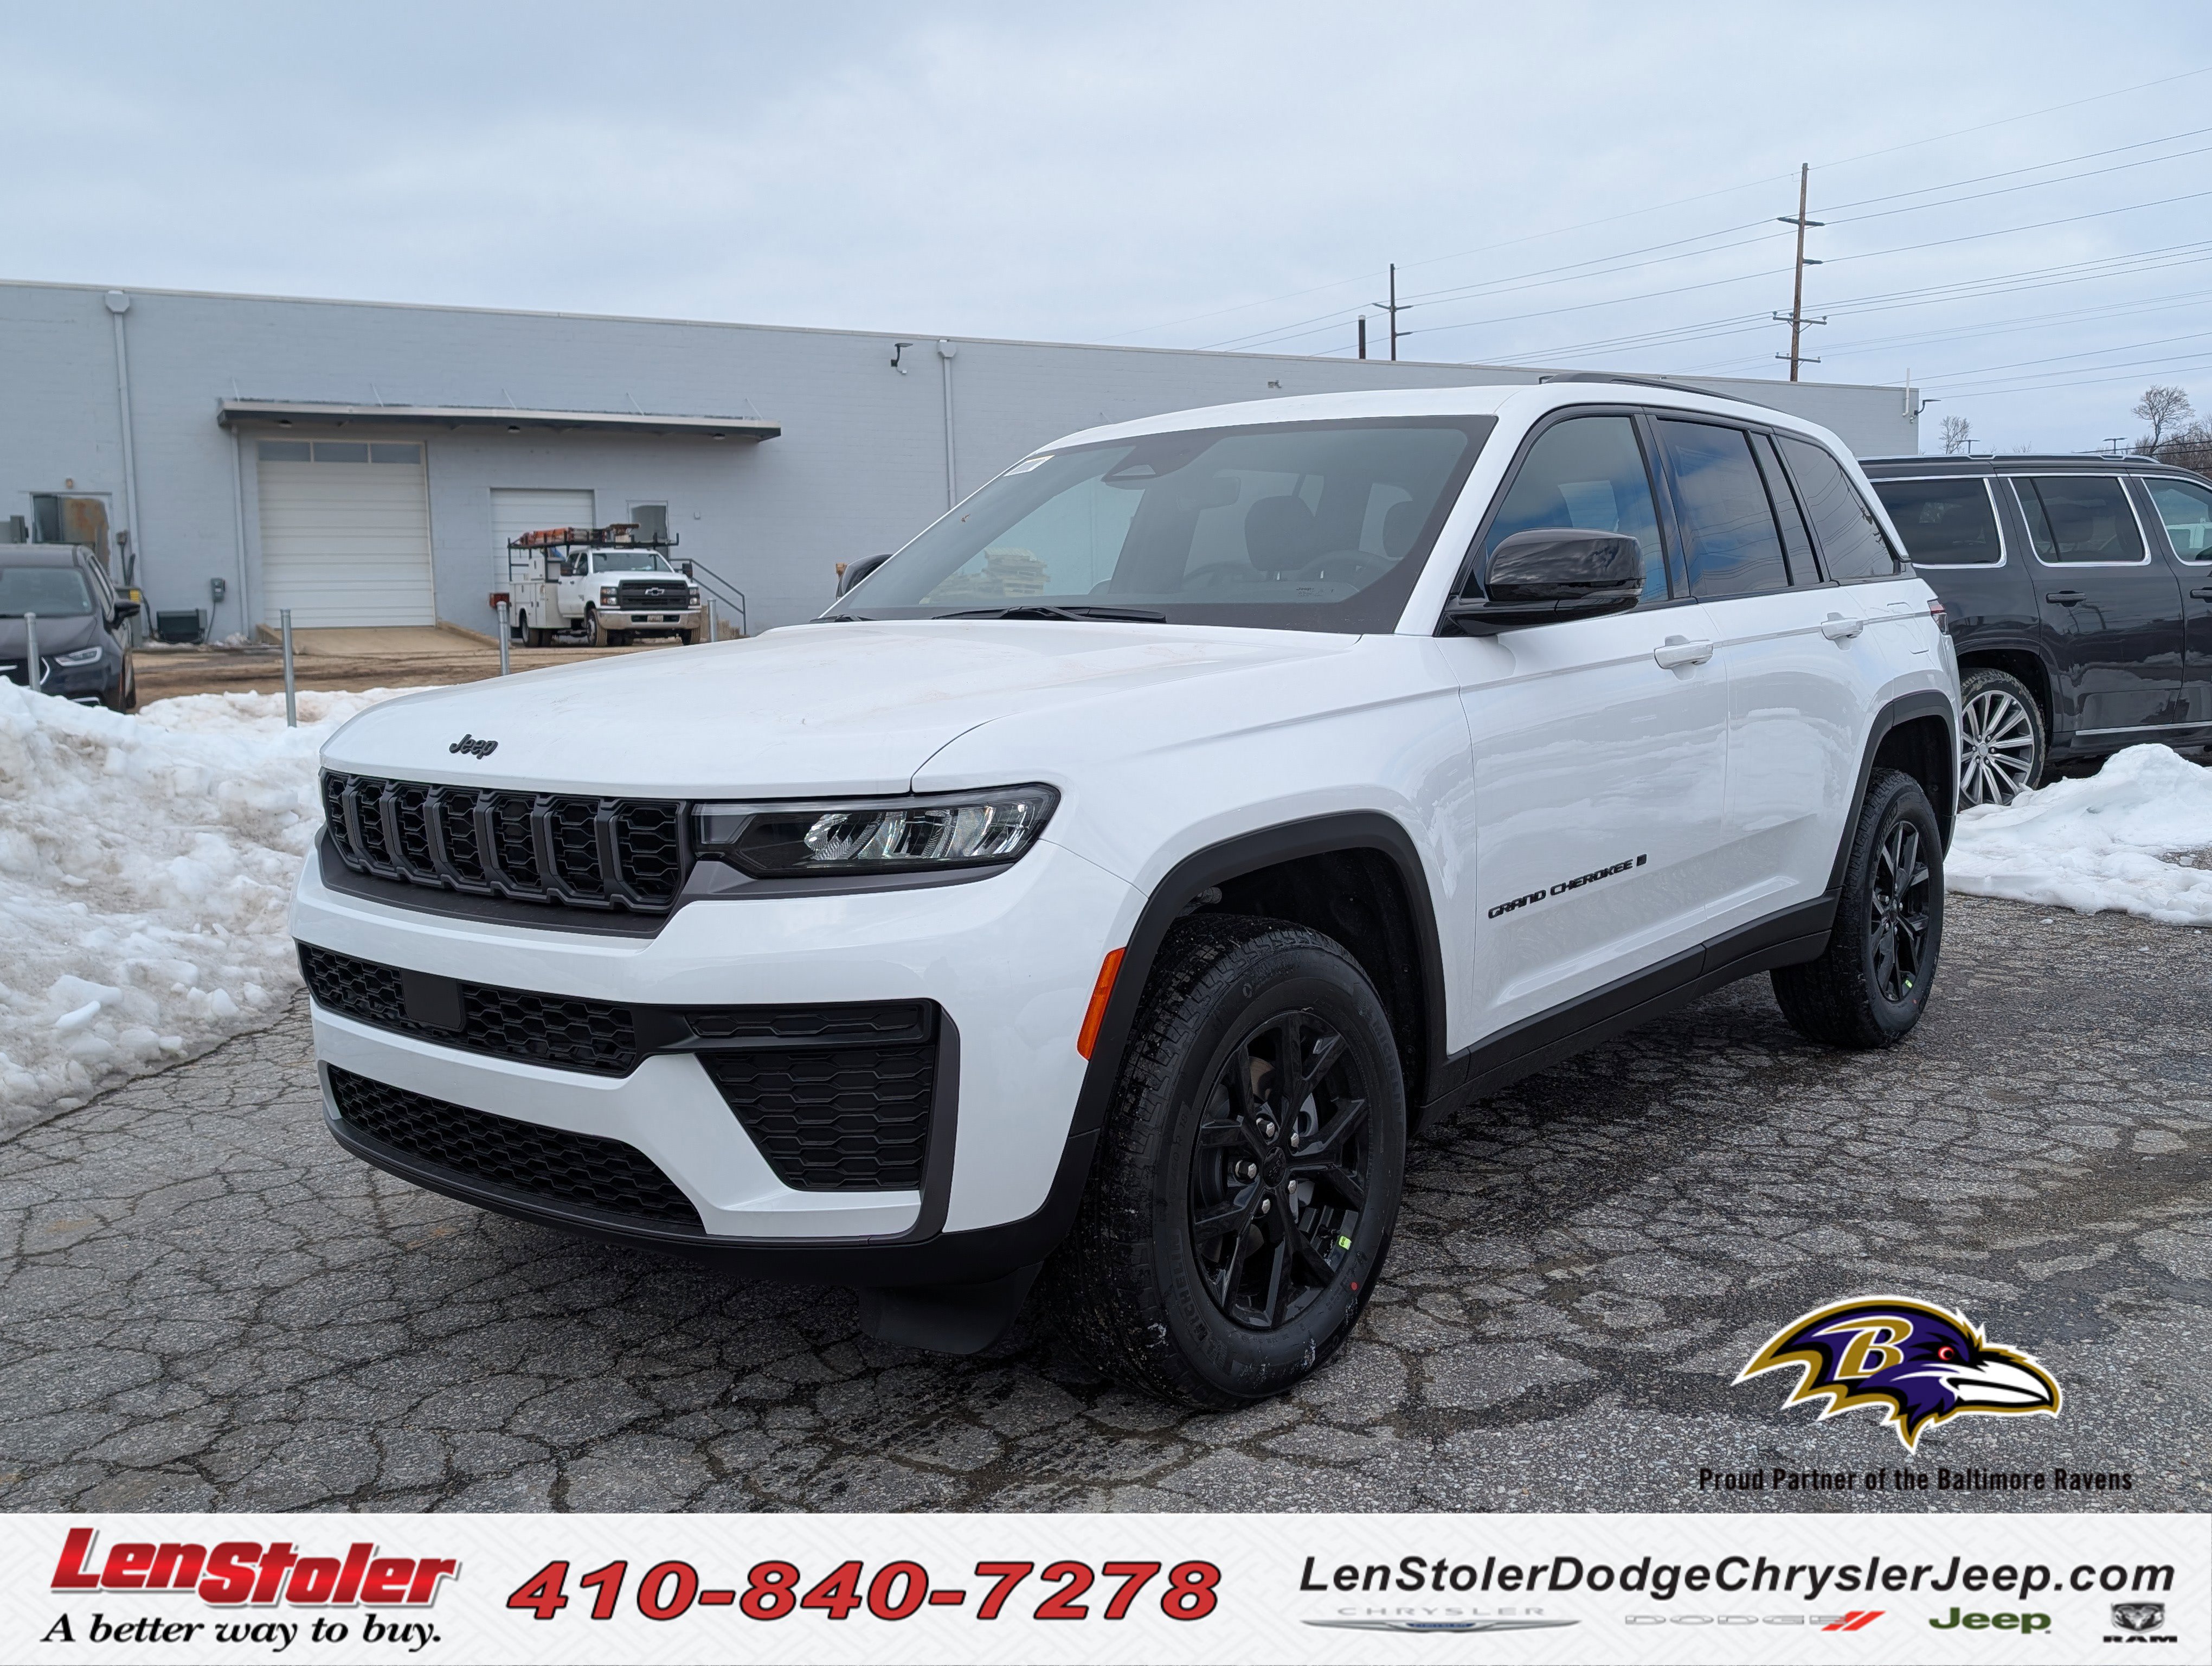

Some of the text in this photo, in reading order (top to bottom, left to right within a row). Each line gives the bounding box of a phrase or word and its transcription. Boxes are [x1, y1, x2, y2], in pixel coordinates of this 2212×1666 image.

[449, 734, 498, 760] Jeep
[1488, 858, 1634, 919] GRAND CHEROKEE
